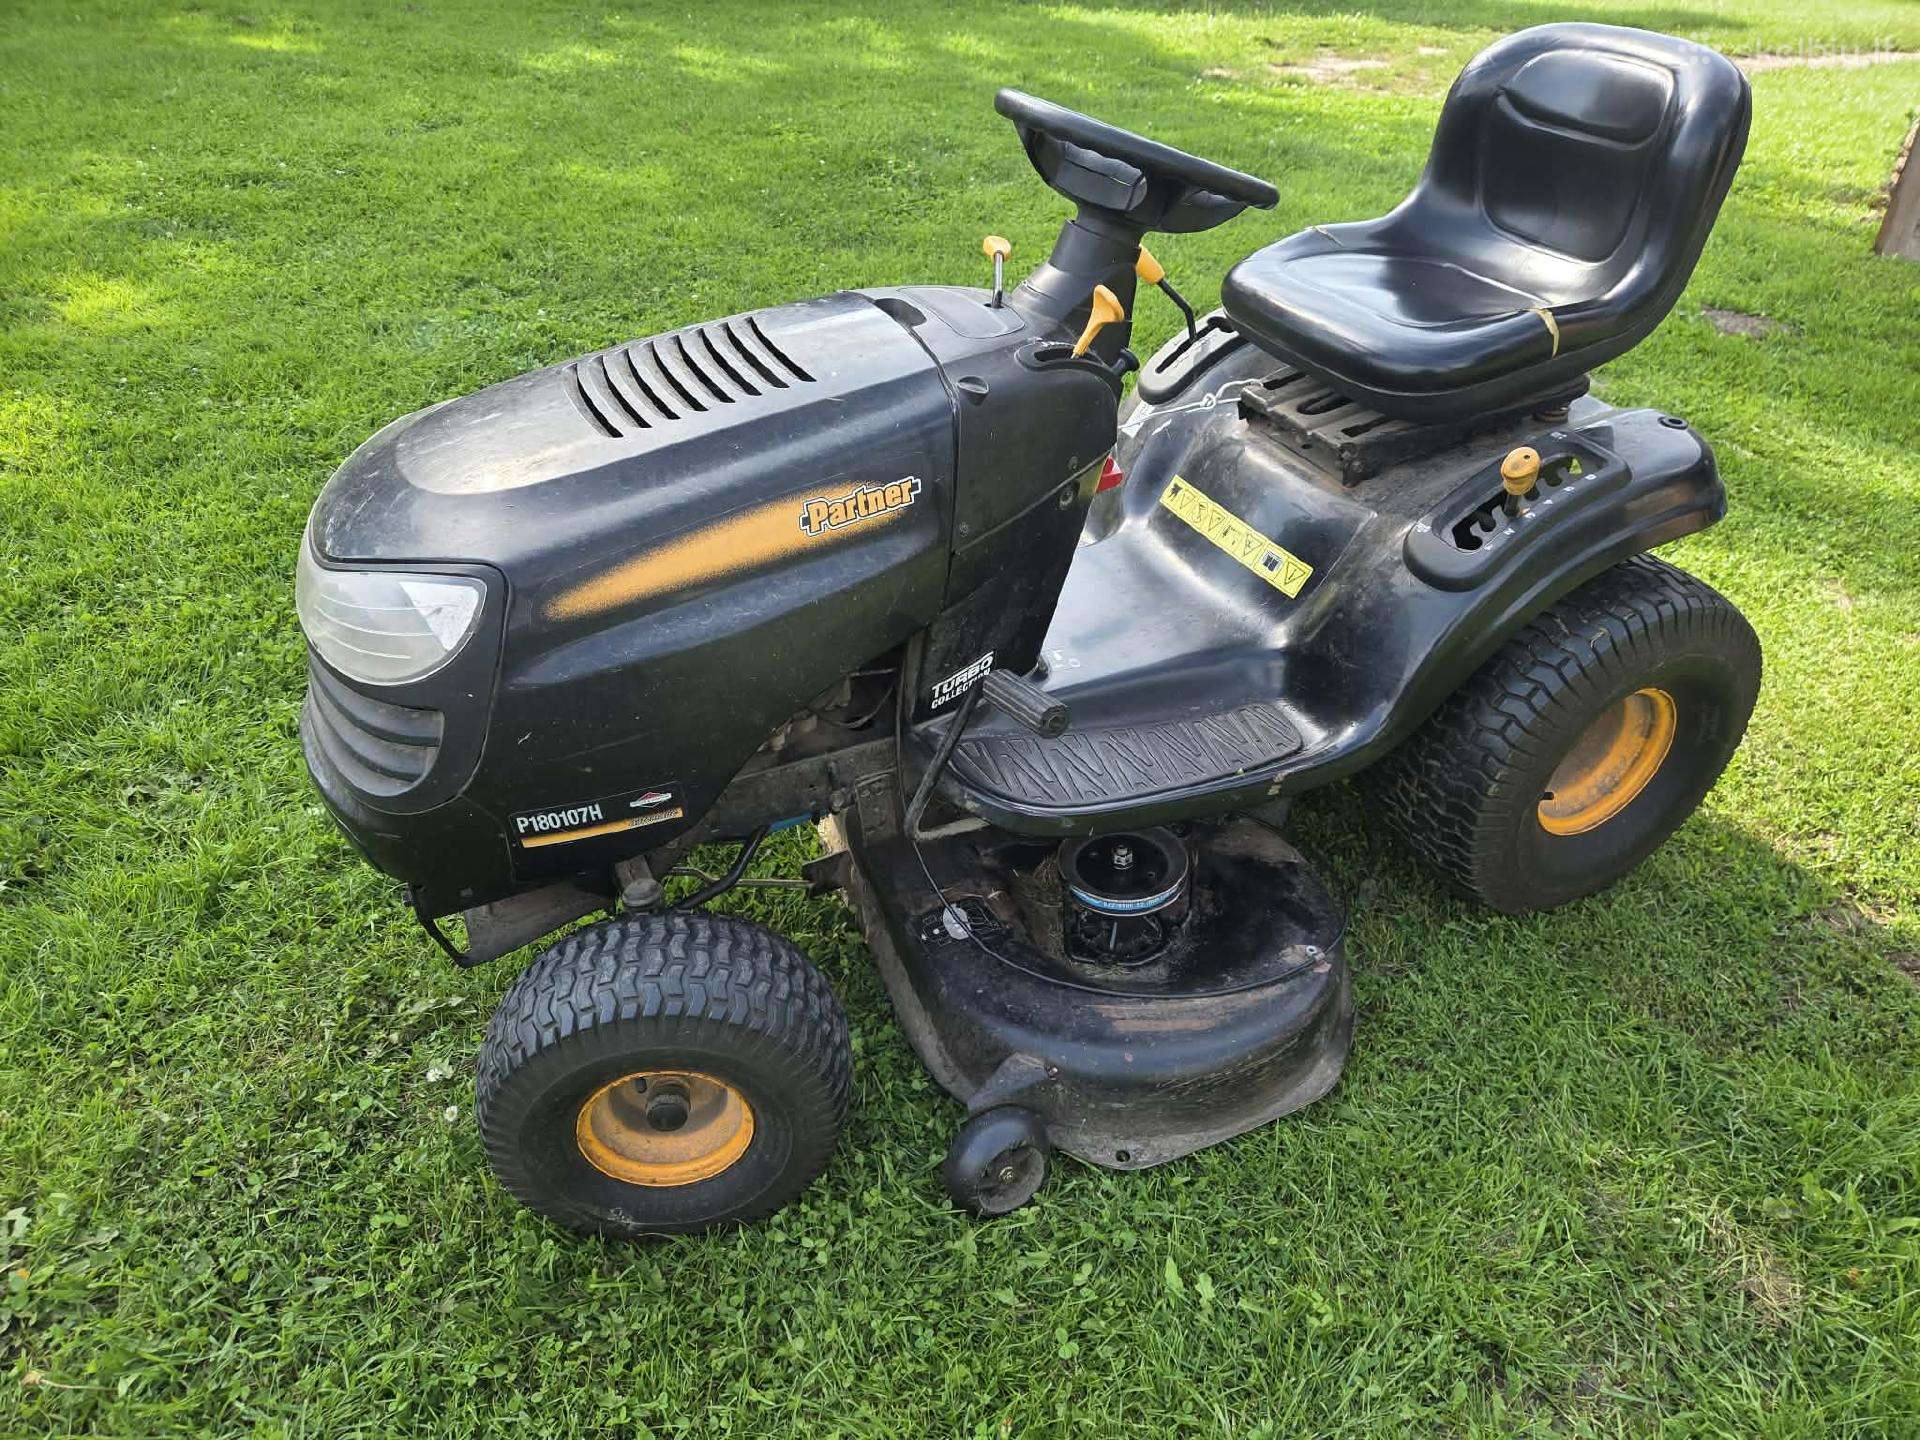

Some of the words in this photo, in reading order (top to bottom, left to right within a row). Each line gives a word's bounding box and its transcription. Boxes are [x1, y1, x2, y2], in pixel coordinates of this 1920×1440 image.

[803, 478, 916, 535] Partner
[931, 651, 994, 698] TURBO
[516, 803, 604, 834] P180107H
